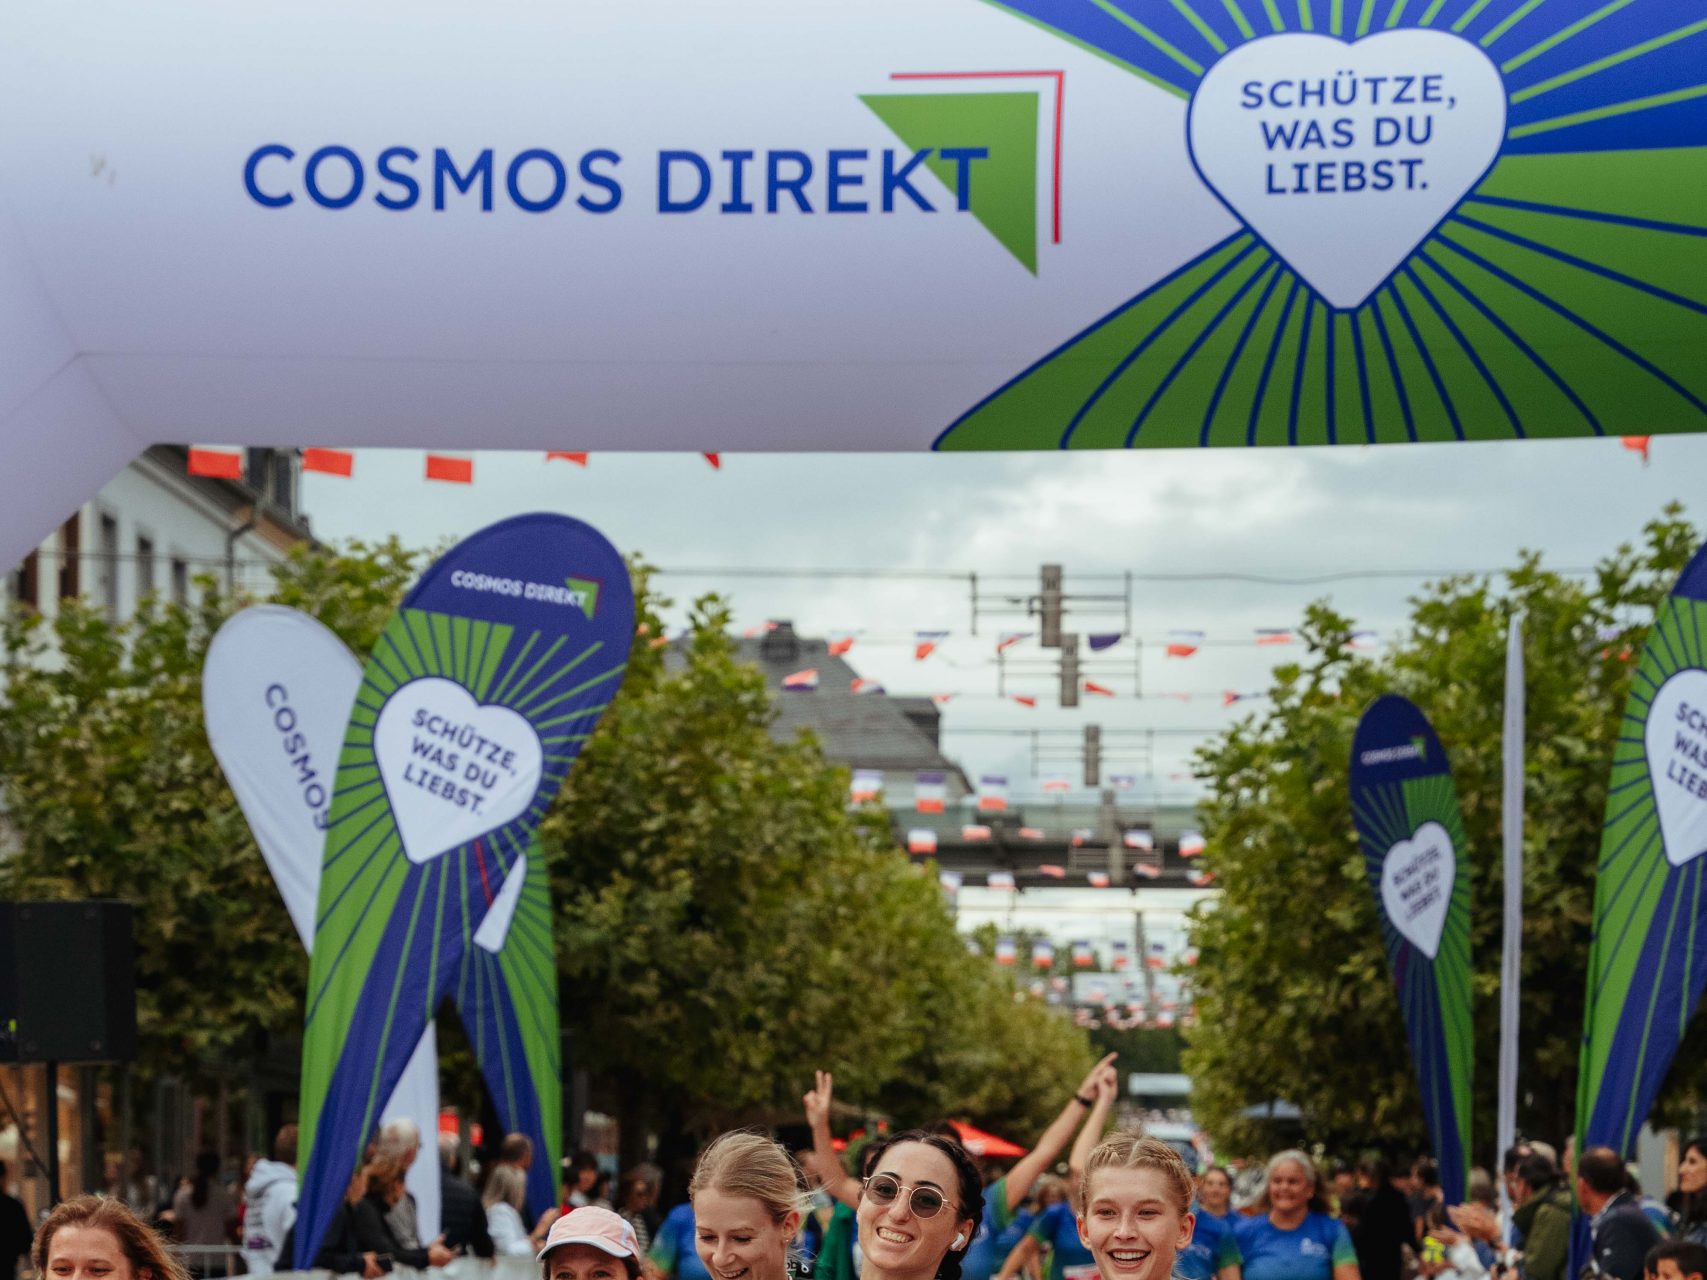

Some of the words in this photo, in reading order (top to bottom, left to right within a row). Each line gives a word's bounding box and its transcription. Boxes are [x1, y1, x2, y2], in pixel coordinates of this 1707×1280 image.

[1240, 70, 1457, 110] SCHÜTZE,
[1261, 118, 1356, 151] WAS
[1374, 115, 1433, 147] DU
[242, 143, 623, 214] COSMOS
[657, 147, 990, 214] DIREKT
[1266, 159, 1428, 195] LIEBST.
[450, 569, 524, 598] COSMOS
[524, 582, 588, 608] DIREKT
[265, 683, 330, 831] COSMOS
[412, 708, 517, 778] SCHÜTZE,
[412, 735, 460, 772] WAS
[464, 761, 498, 789] DU
[403, 762, 485, 816] LIEBST.
